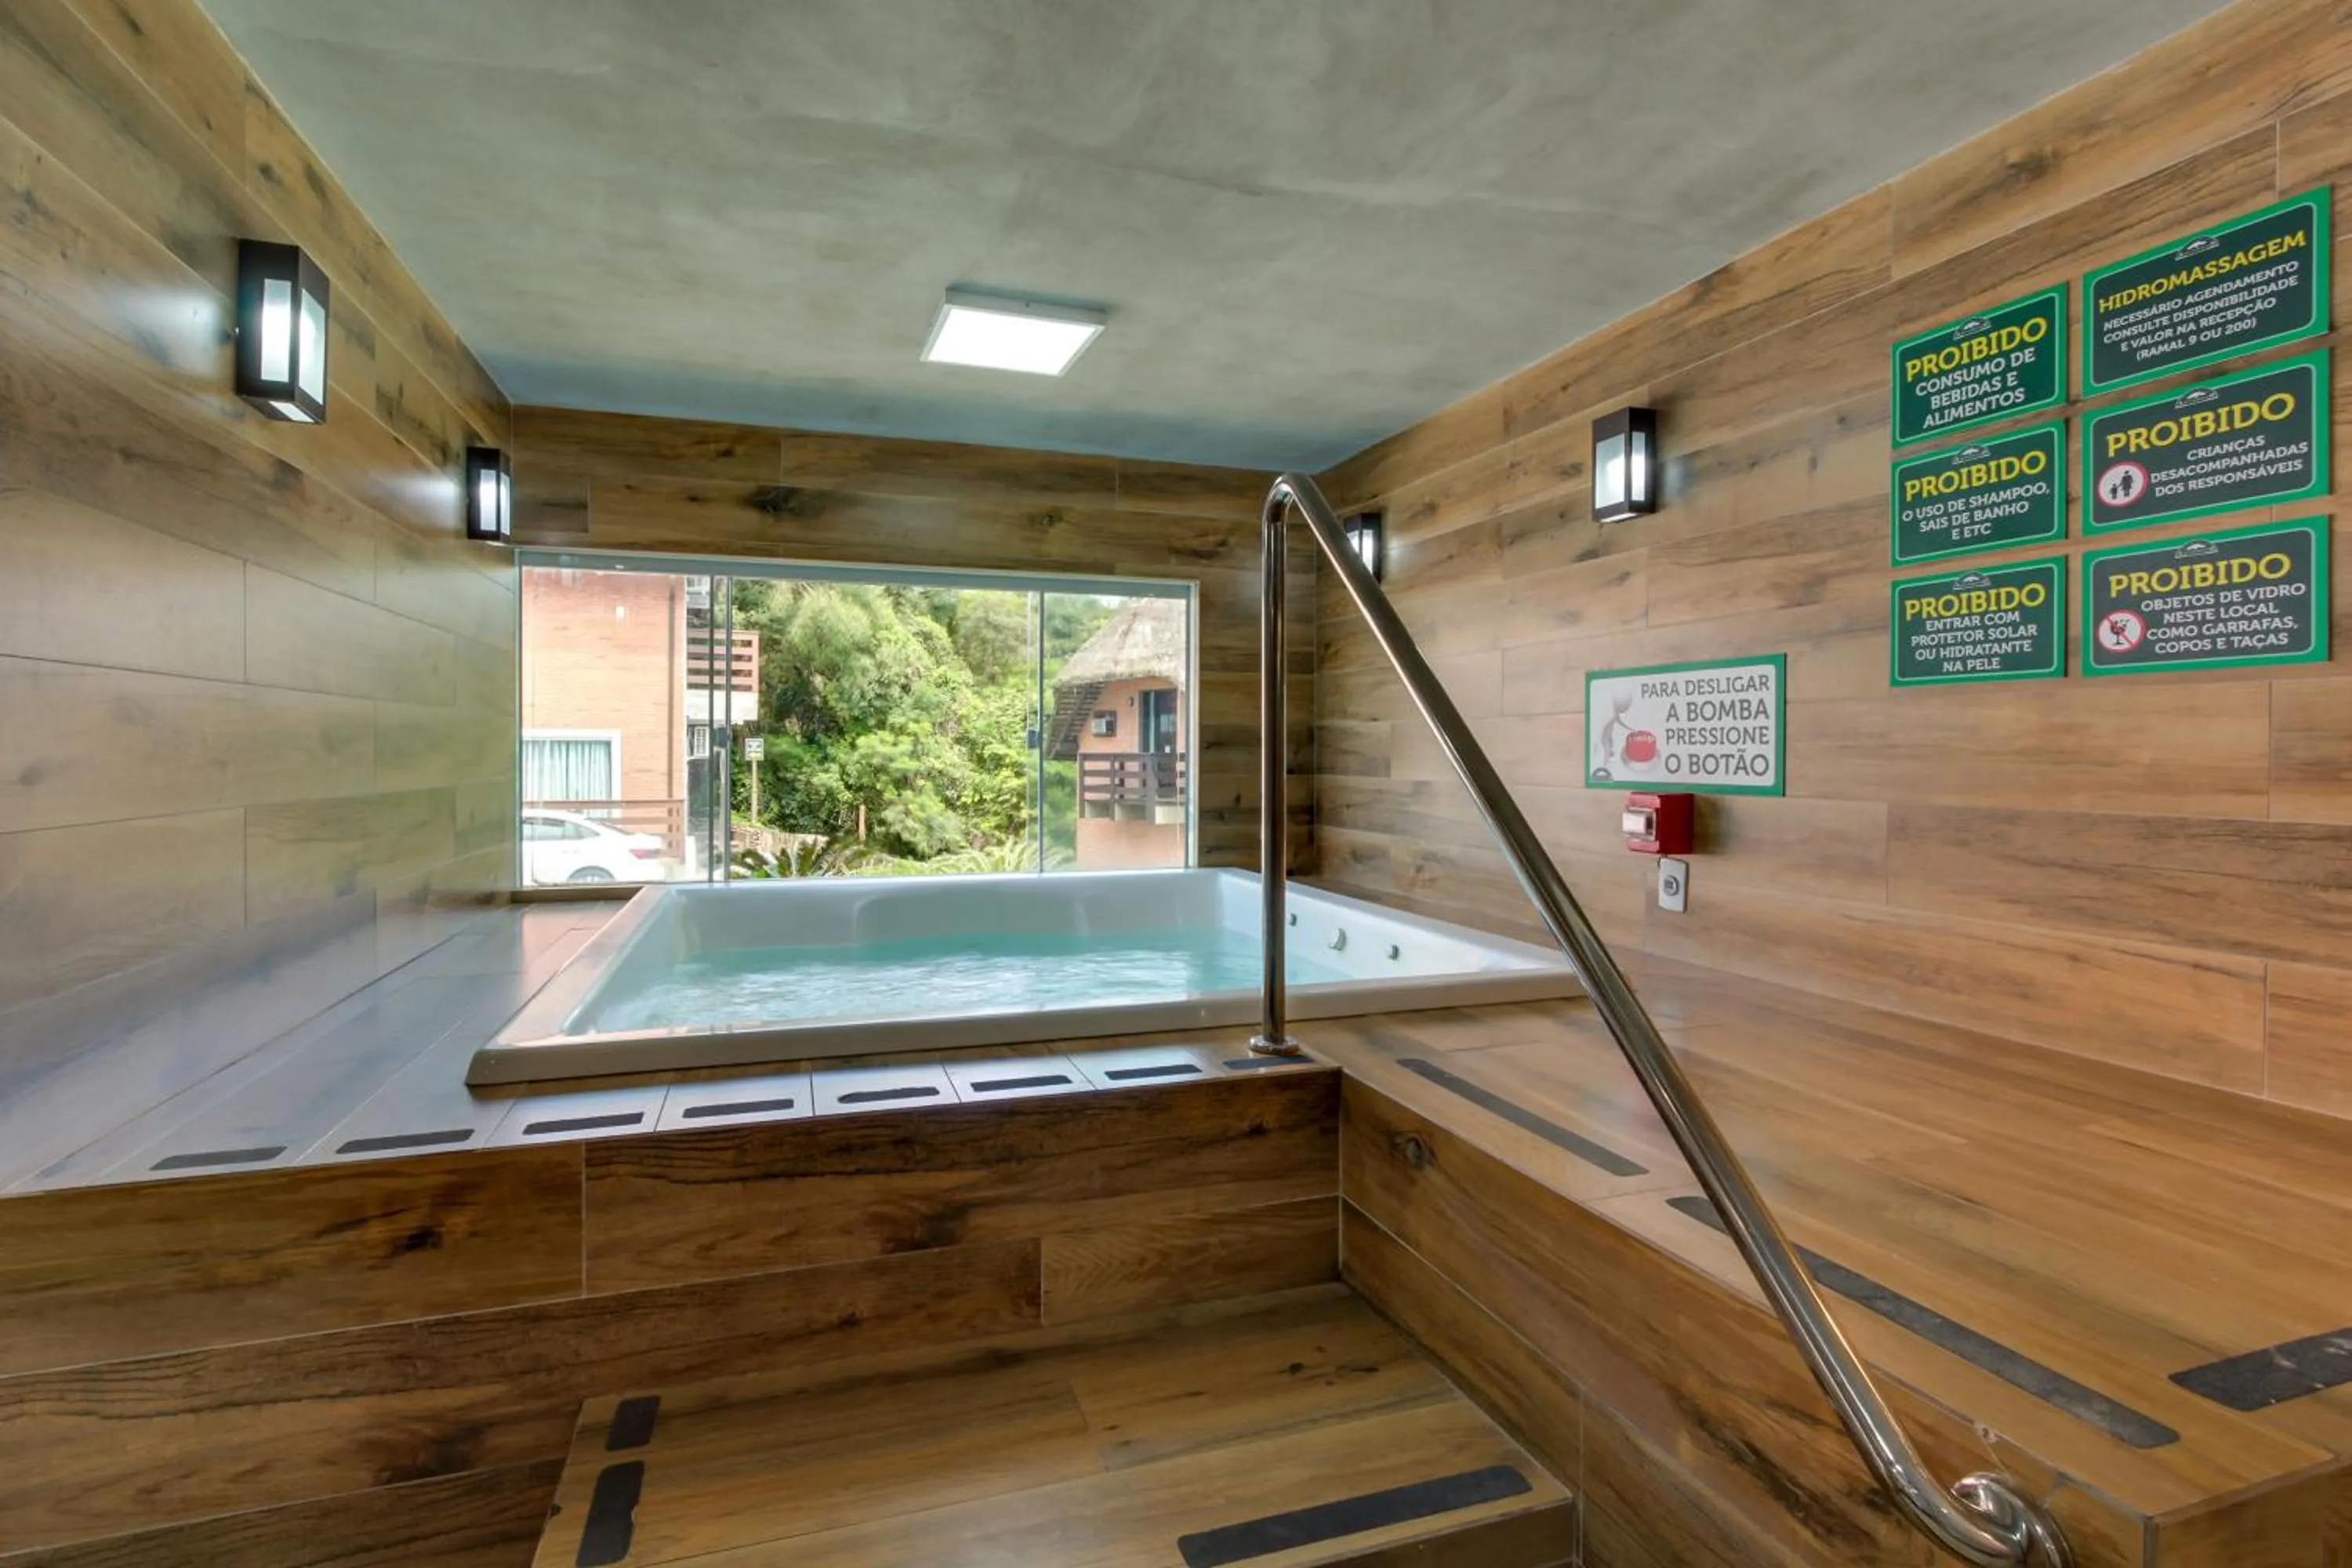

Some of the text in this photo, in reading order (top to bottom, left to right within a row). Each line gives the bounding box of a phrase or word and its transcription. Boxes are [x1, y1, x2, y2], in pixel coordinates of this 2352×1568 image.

[2098, 230, 2307, 314] HIDROMASSAGEM
[2184, 260, 2299, 305] AGENDAMENTO
[2103, 275, 2299, 343] CONSULTE DISPONIBILIDADE
[2120, 297, 2277, 352] E VALOR NA RECEPÇÃO
[2188, 335, 2198, 346] 9
[2199, 327, 2222, 341] OU
[2225, 316, 2257, 335] 200)
[1905, 317, 2048, 382] PROIBIDO
[1915, 347, 2036, 396] CONSUMO DE
[1930, 371, 2019, 410] BEBIDAS E
[1922, 388, 2027, 429] ALIMENTOS
[2106, 391, 2296, 458] PROIBIDO
[2151, 441, 2308, 484] DESACOMPANHADAS
[2187, 435, 2266, 460] CRIANÇAS
[1904, 451, 2047, 502] PROIBIDO
[2154, 459, 2303, 497] DOS RESPONSÁVEIS
[1902, 481, 2050, 521] O USO DE SHAMPOO,
[1919, 501, 2029, 532] SAIS DE BANHO
[1951, 523, 1992, 540] E ETC
[2109, 553, 2291, 598] PROIBIDO
[1904, 583, 2045, 621] PROIBIDO
[2141, 583, 2306, 612] OBJETOS DE VIDRO
[2163, 602, 2279, 624] NESTE LOCAL
[1911, 624, 2038, 647] PROTETOR SOLAR
[1926, 611, 2020, 631] ENTRAR COM
[2146, 616, 2298, 641] COMO GARRAFAS,
[1915, 640, 2033, 661] OU HIDRATANTE
[2155, 633, 2288, 654] COPOS E TAÇAS
[1943, 658, 2001, 673] NA PELE
[1641, 674, 1770, 699] PARA DESLIGAR
[1665, 698, 1769, 723] A BOMBA
[1665, 726, 1769, 746] PRESSIONE
[1664, 748, 1769, 777] O BOTÃO
